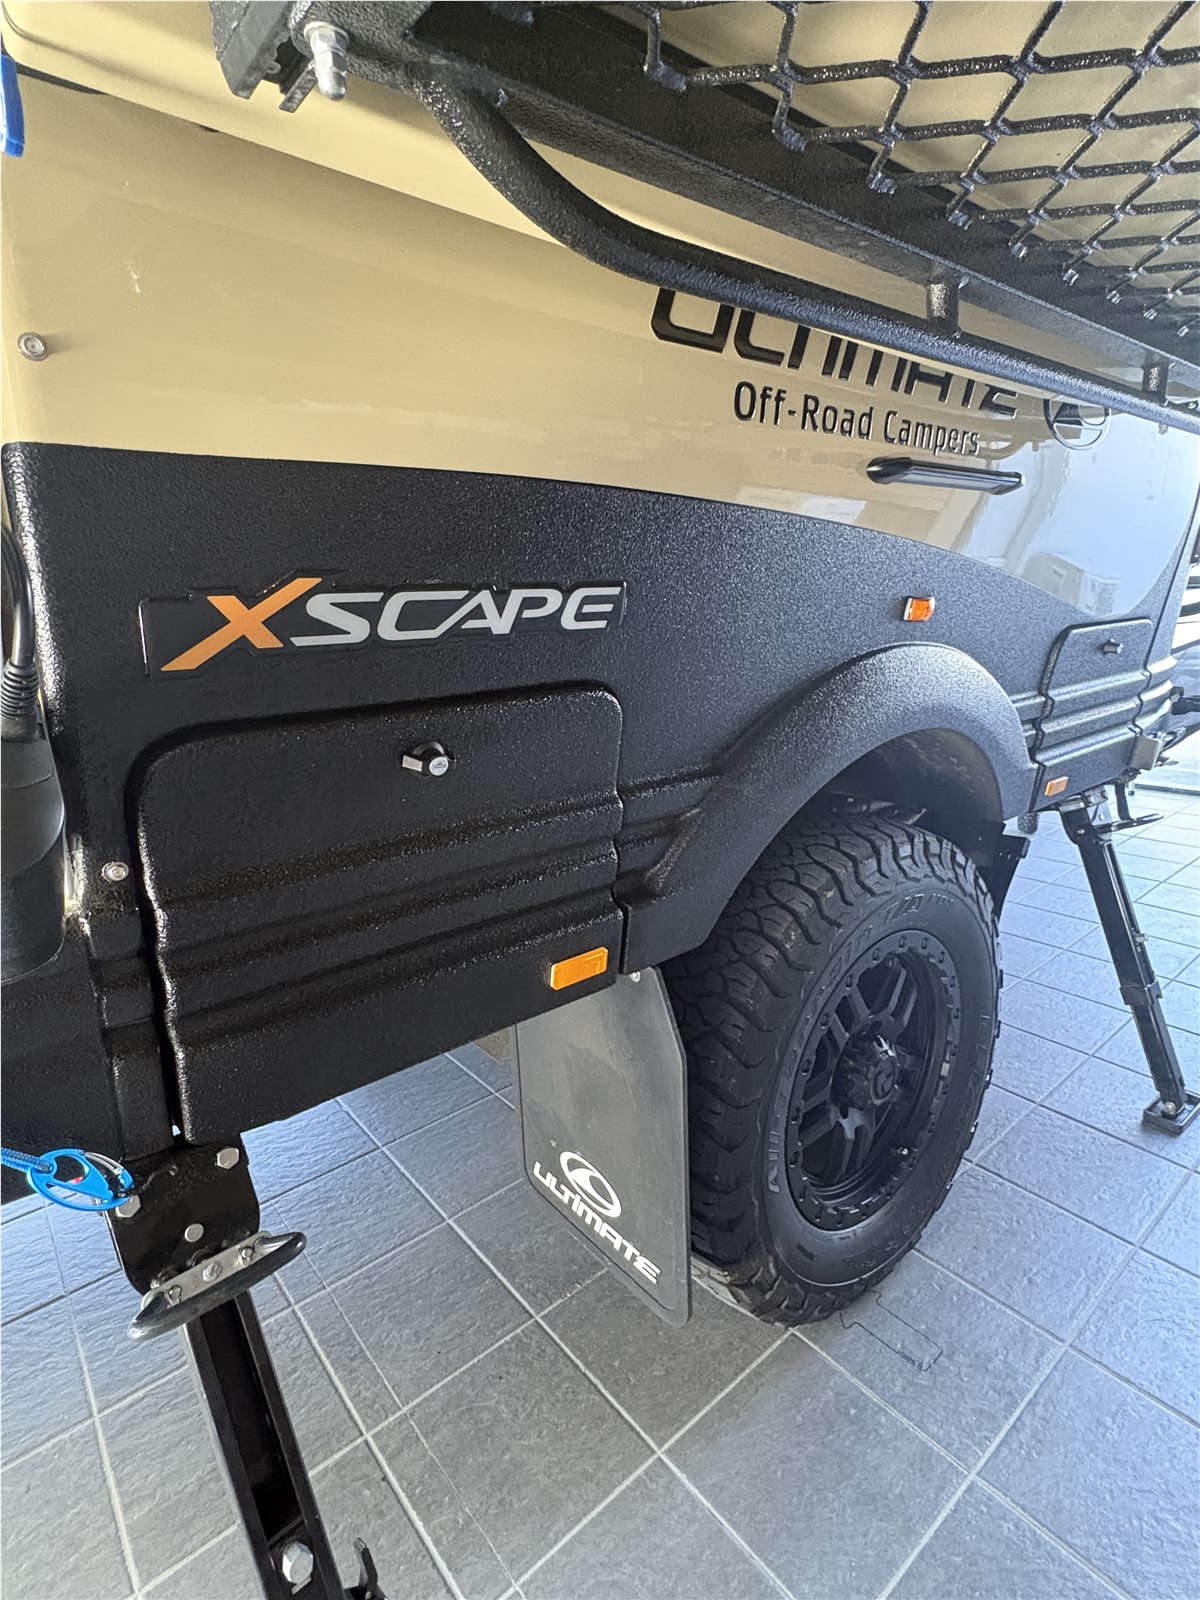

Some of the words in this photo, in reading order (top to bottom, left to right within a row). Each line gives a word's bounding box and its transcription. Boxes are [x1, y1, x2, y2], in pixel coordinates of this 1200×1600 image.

[734, 381, 874, 440] Off-Road
[884, 410, 981, 456] Campers
[160, 577, 622, 672] XSCAPE
[533, 1161, 661, 1284] ULTIMATE
